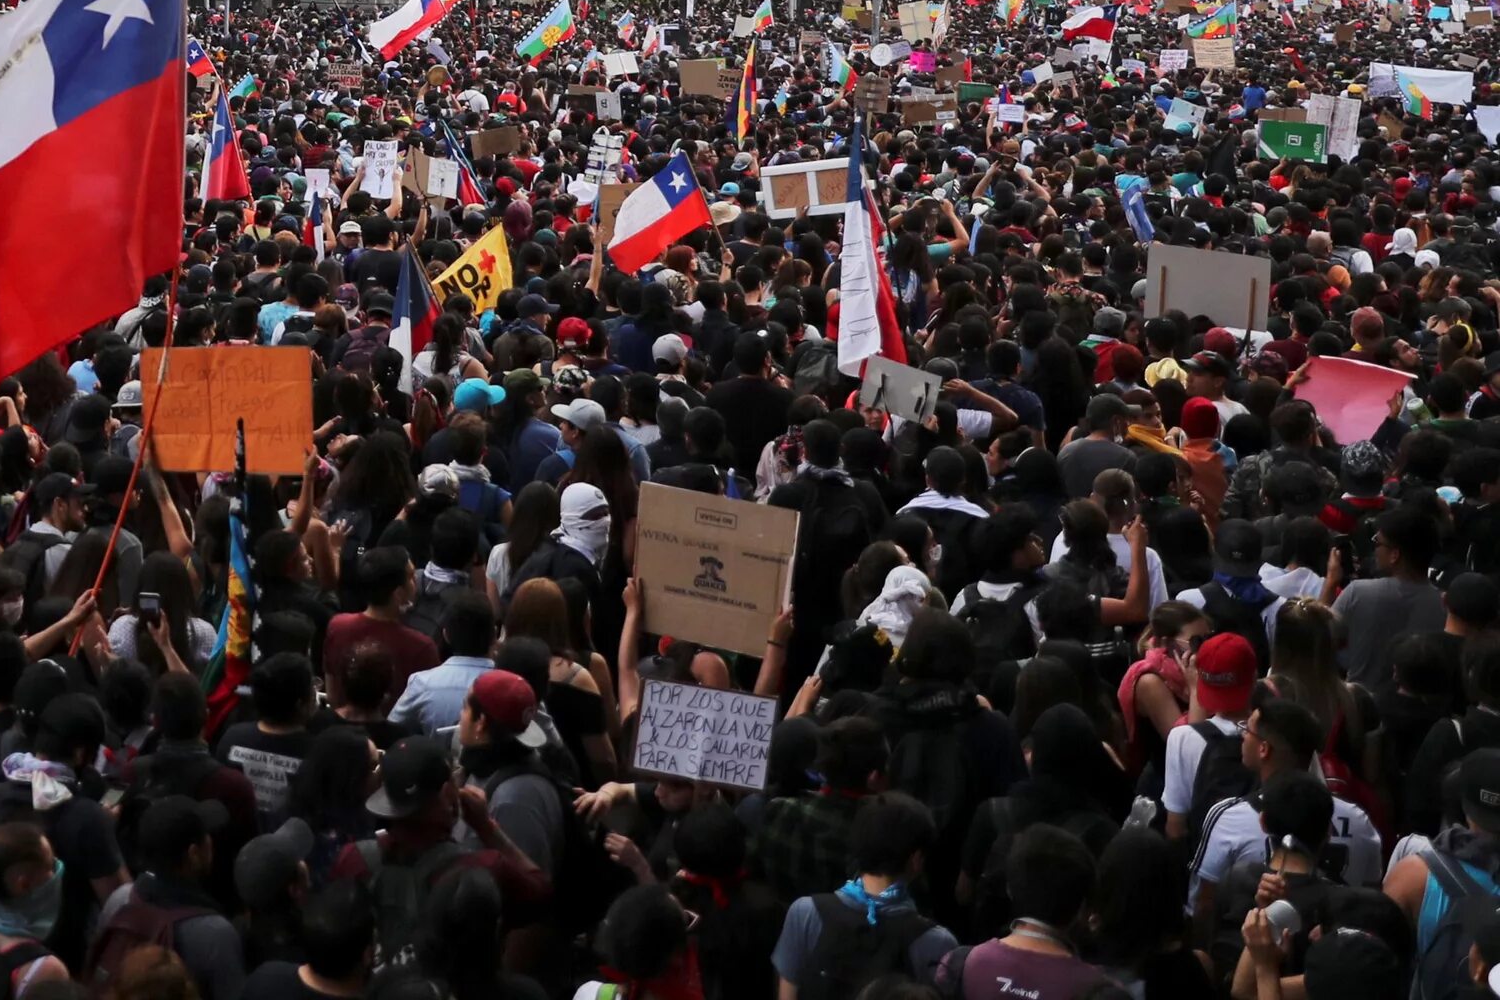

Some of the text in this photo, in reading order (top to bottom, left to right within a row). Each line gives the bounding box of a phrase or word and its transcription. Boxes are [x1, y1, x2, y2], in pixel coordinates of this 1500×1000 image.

[650, 683, 770, 719] POR LOS QUE
[641, 708, 773, 742] ALZARON LA VOZ
[637, 741, 677, 769] PARA
[665, 730, 699, 751] LOS
[700, 735, 770, 760] CALLARON
